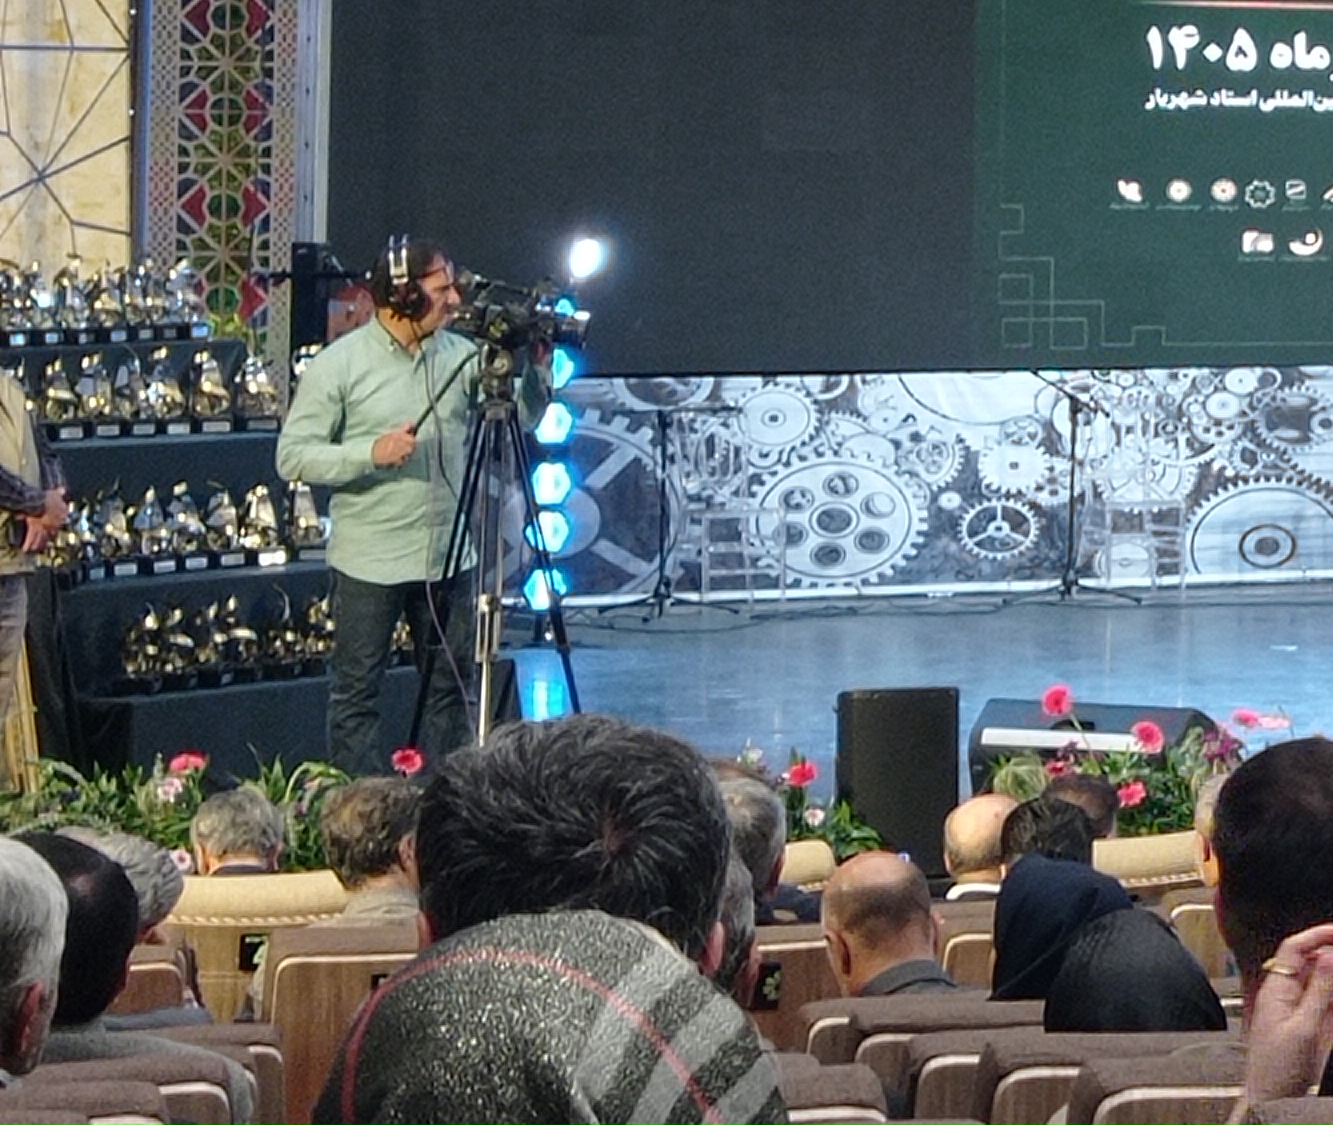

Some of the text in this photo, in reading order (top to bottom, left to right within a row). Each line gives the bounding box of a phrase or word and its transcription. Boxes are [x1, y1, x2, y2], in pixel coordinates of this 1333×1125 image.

[1146, 24, 1258, 72] ۱۴۰۵
[1144, 87, 1208, 111] شهریار
[1209, 87, 1259, 108] استاد
